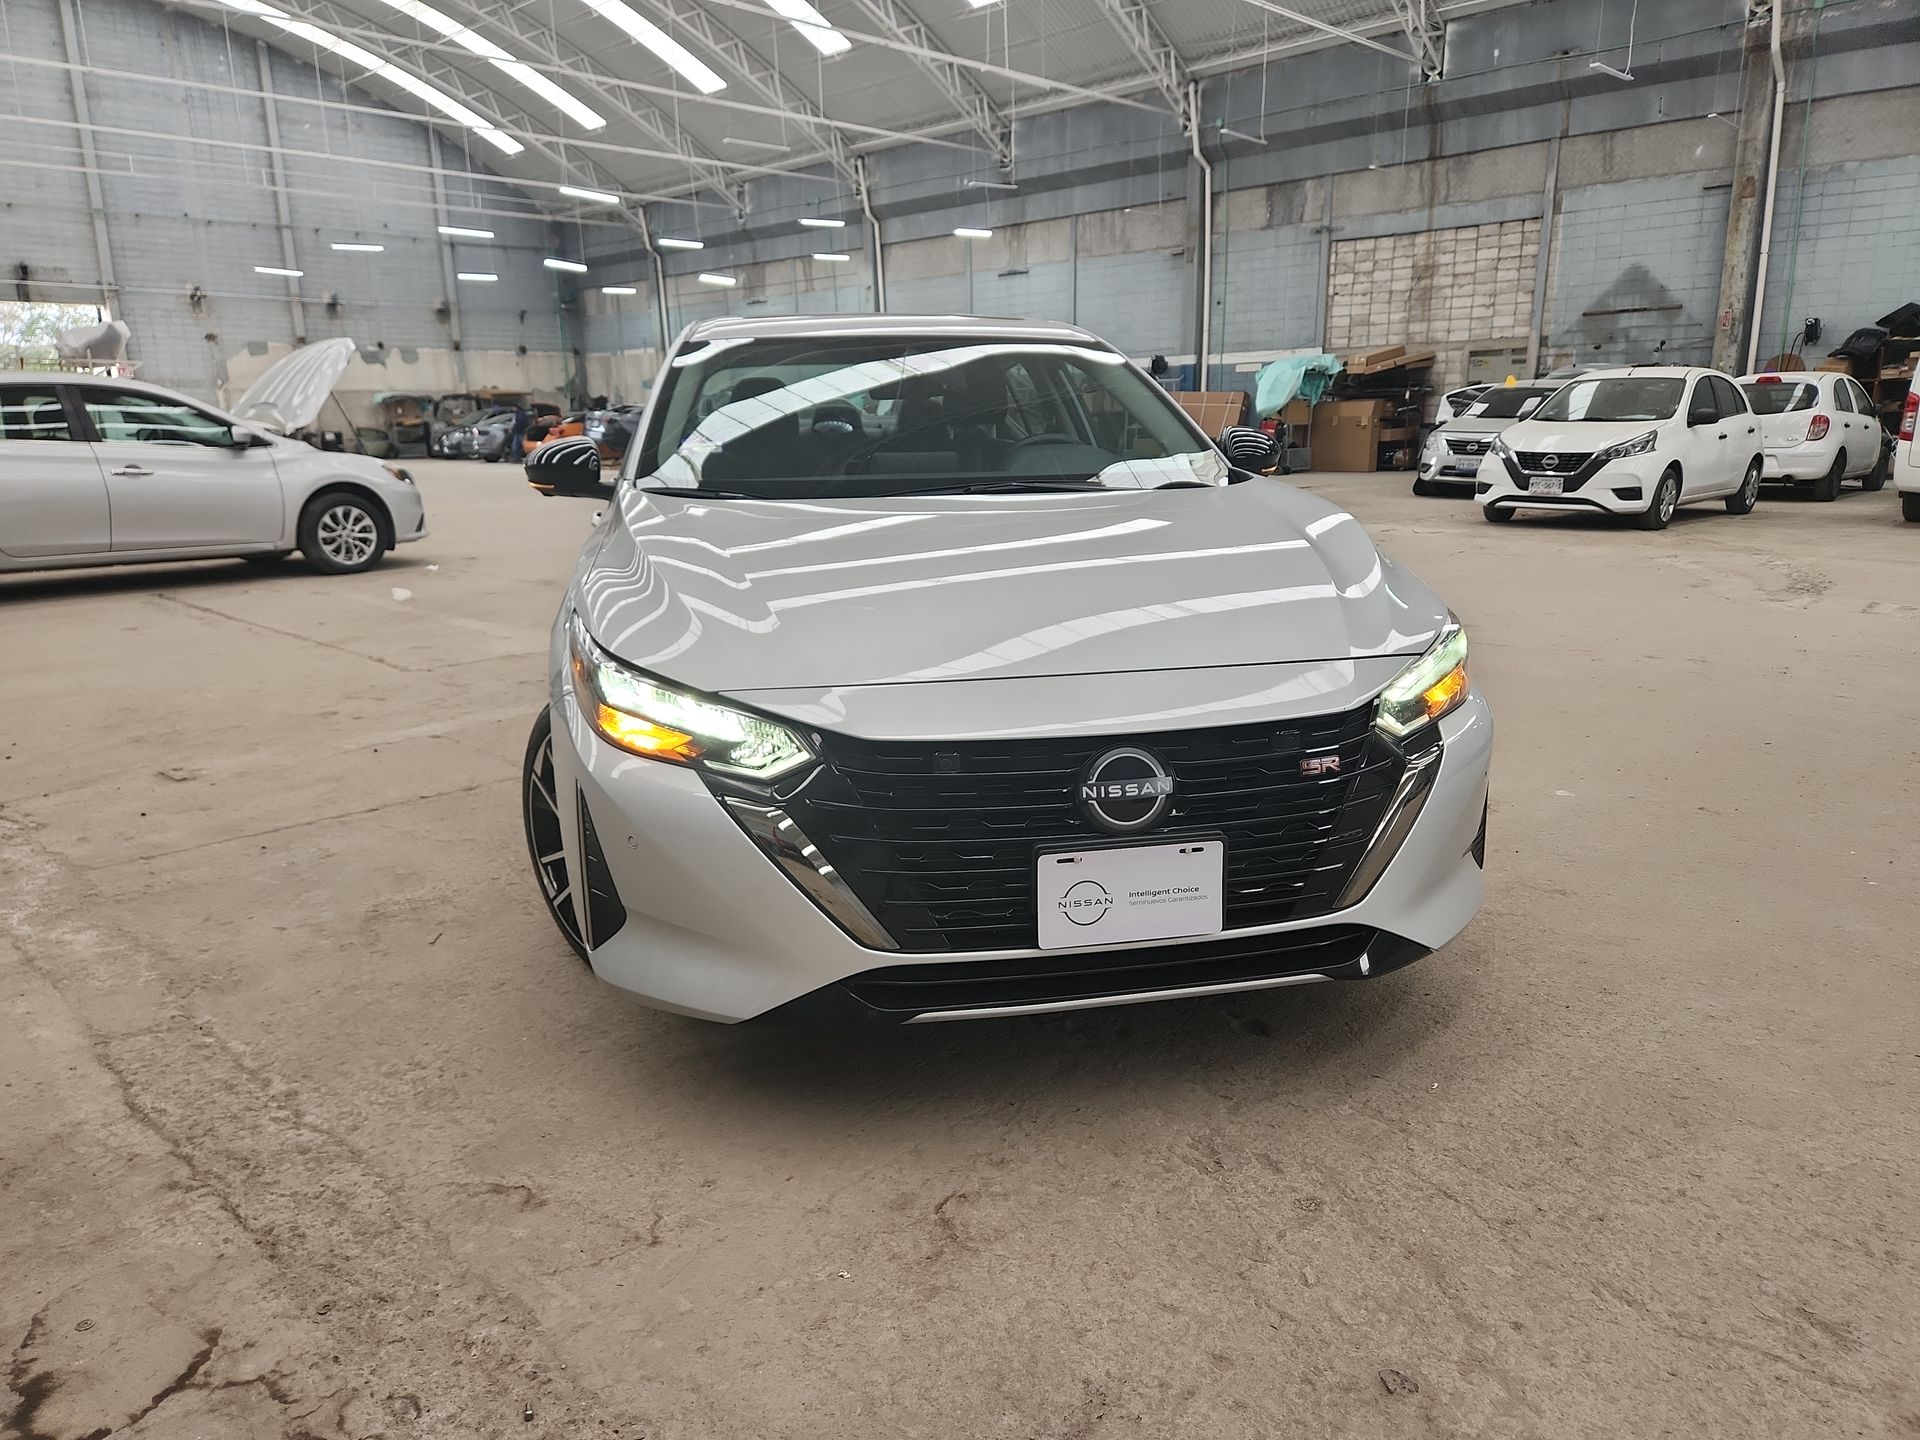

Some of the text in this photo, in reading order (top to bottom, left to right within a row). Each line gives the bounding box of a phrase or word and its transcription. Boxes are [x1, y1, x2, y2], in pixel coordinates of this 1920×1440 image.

[1299, 754, 1341, 776] SR
[1081, 780, 1171, 800] NISSAN
[1128, 885, 1200, 898] Intelligent Choice
[1058, 897, 1114, 910] NISSAN
[1128, 894, 1209, 906] Seminuevos Garantizados
